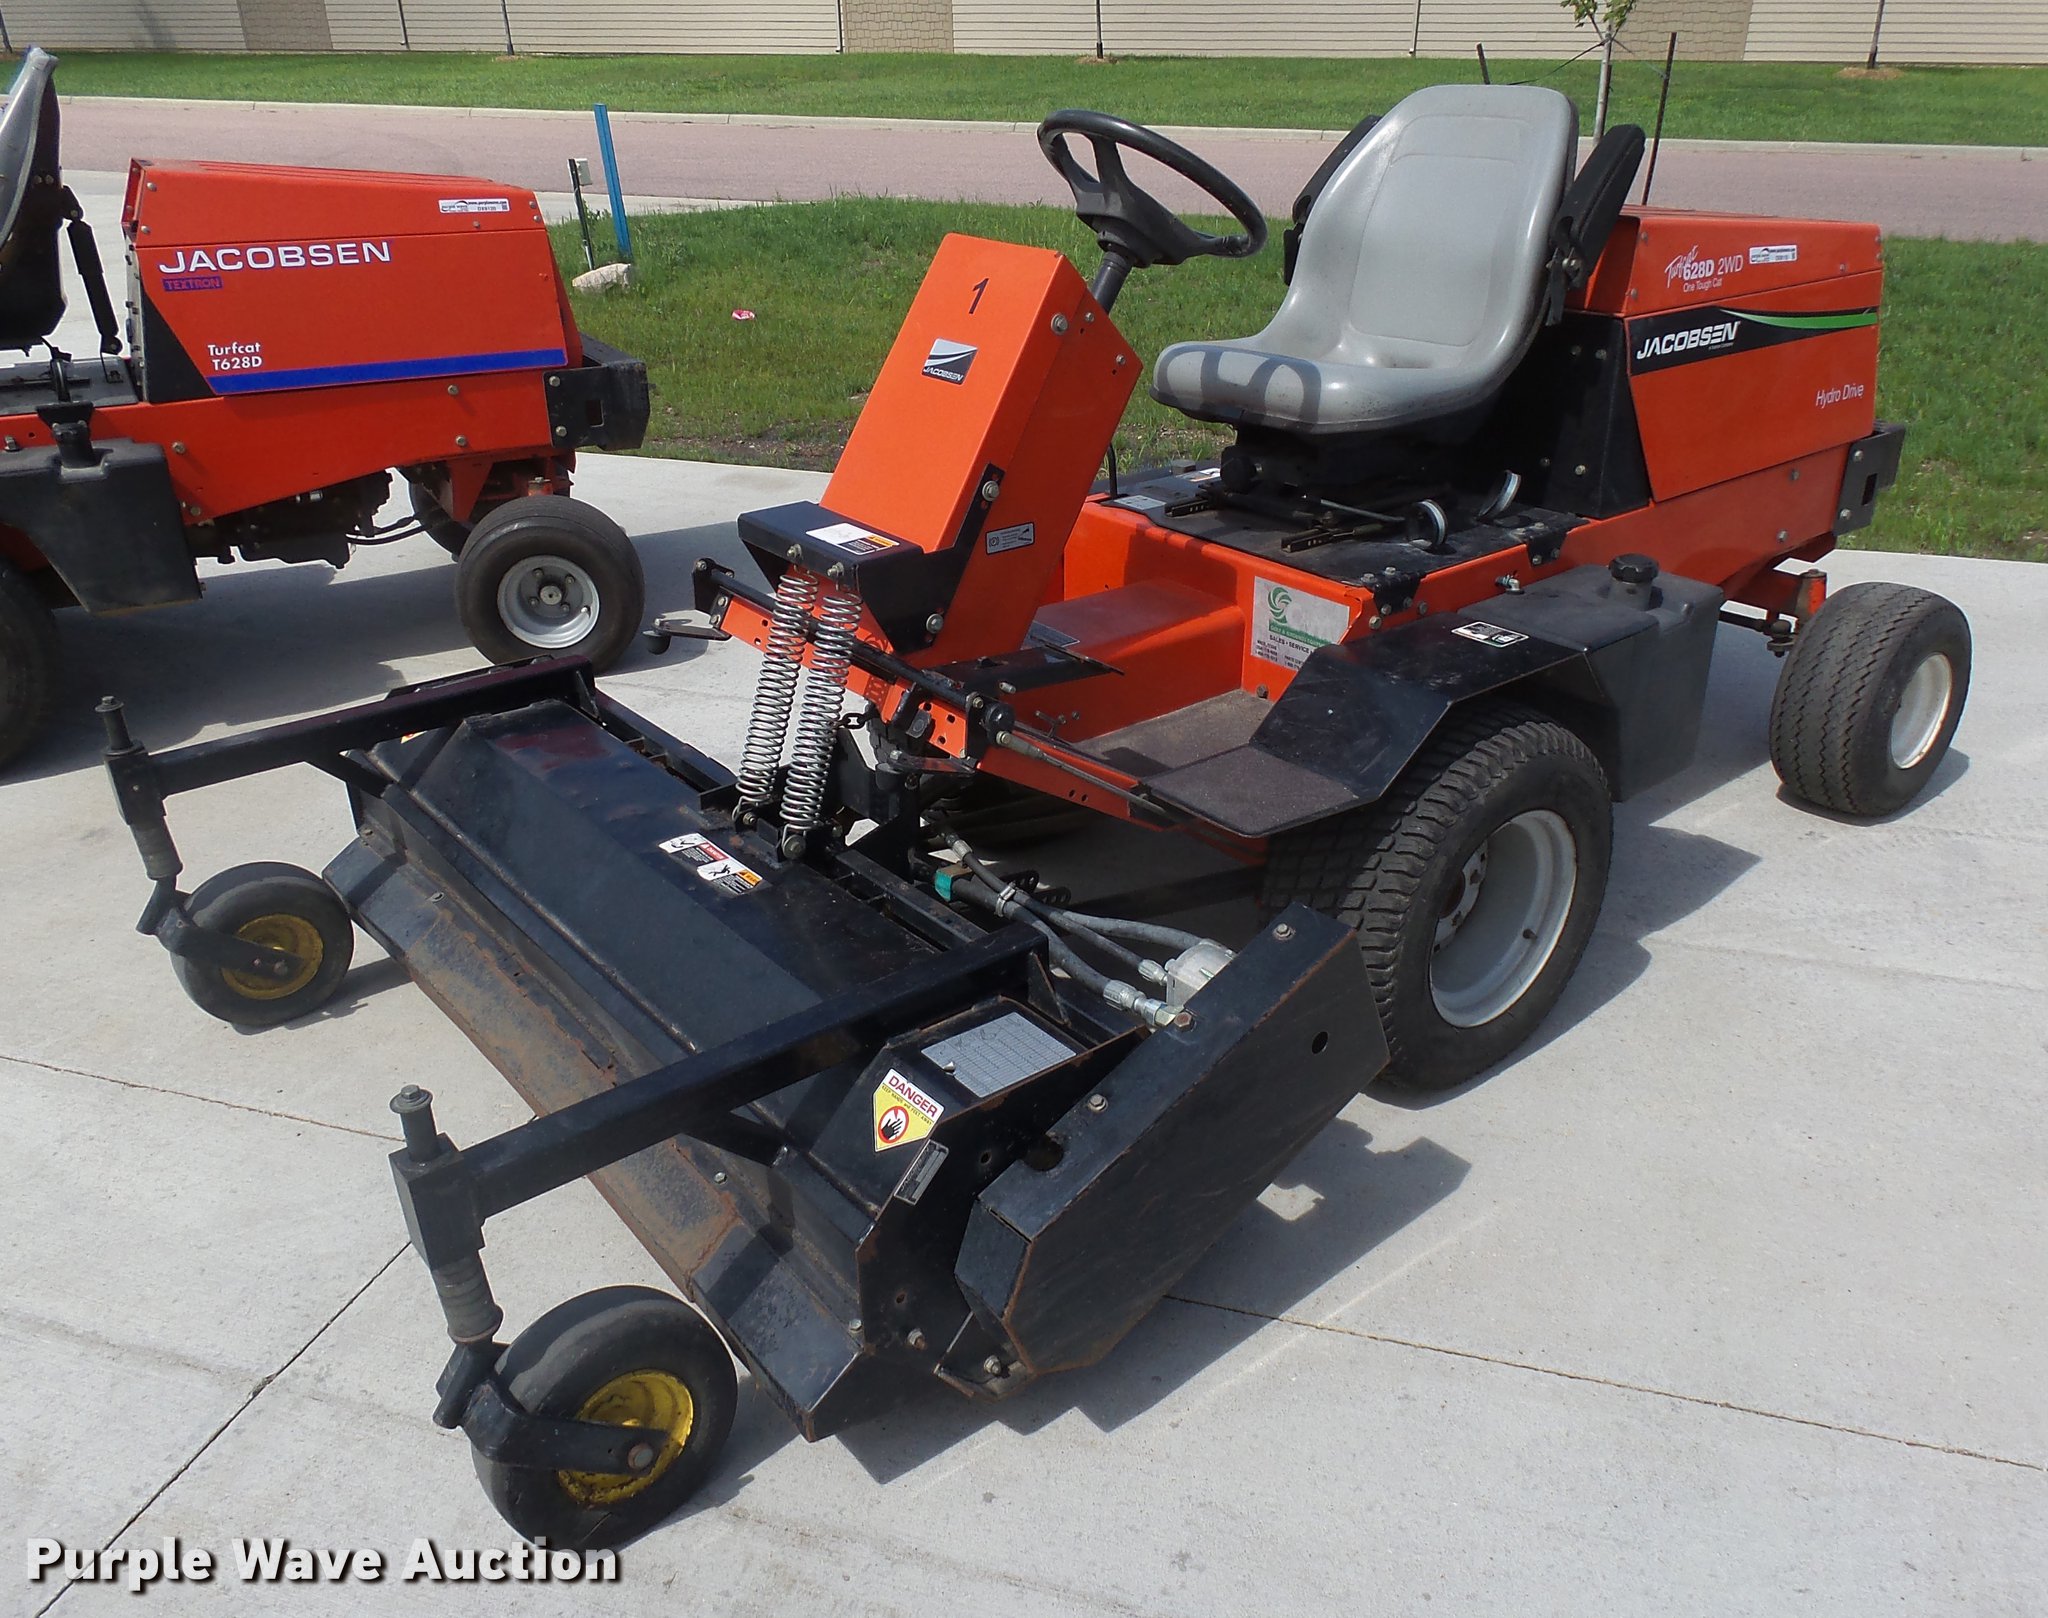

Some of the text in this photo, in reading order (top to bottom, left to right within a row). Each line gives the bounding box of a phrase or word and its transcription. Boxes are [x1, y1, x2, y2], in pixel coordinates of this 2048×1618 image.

[159, 241, 392, 274] JACOBSEN
[1683, 259, 1715, 281] 628D
[1717, 254, 1744, 275] 2WD
[165, 277, 221, 291] TEXTRON
[968, 277, 989, 315] 1
[207, 341, 261, 356] Turfcat
[1636, 321, 1740, 360] JACOBSEN
[212, 356, 263, 371] T628D
[922, 366, 964, 382] JACOBSEN
[1815, 383, 1864, 409] Hydro Drive
[1269, 634, 1285, 645] SALES
[1289, 641, 1310, 654] SERVICE
[882, 1085, 891, 1093] KEEP
[891, 1092, 903, 1104] HANDS
[910, 1108, 921, 1117] FEET
[920, 1116, 932, 1125] AWAY
[888, 1075, 938, 1118] DANGER
